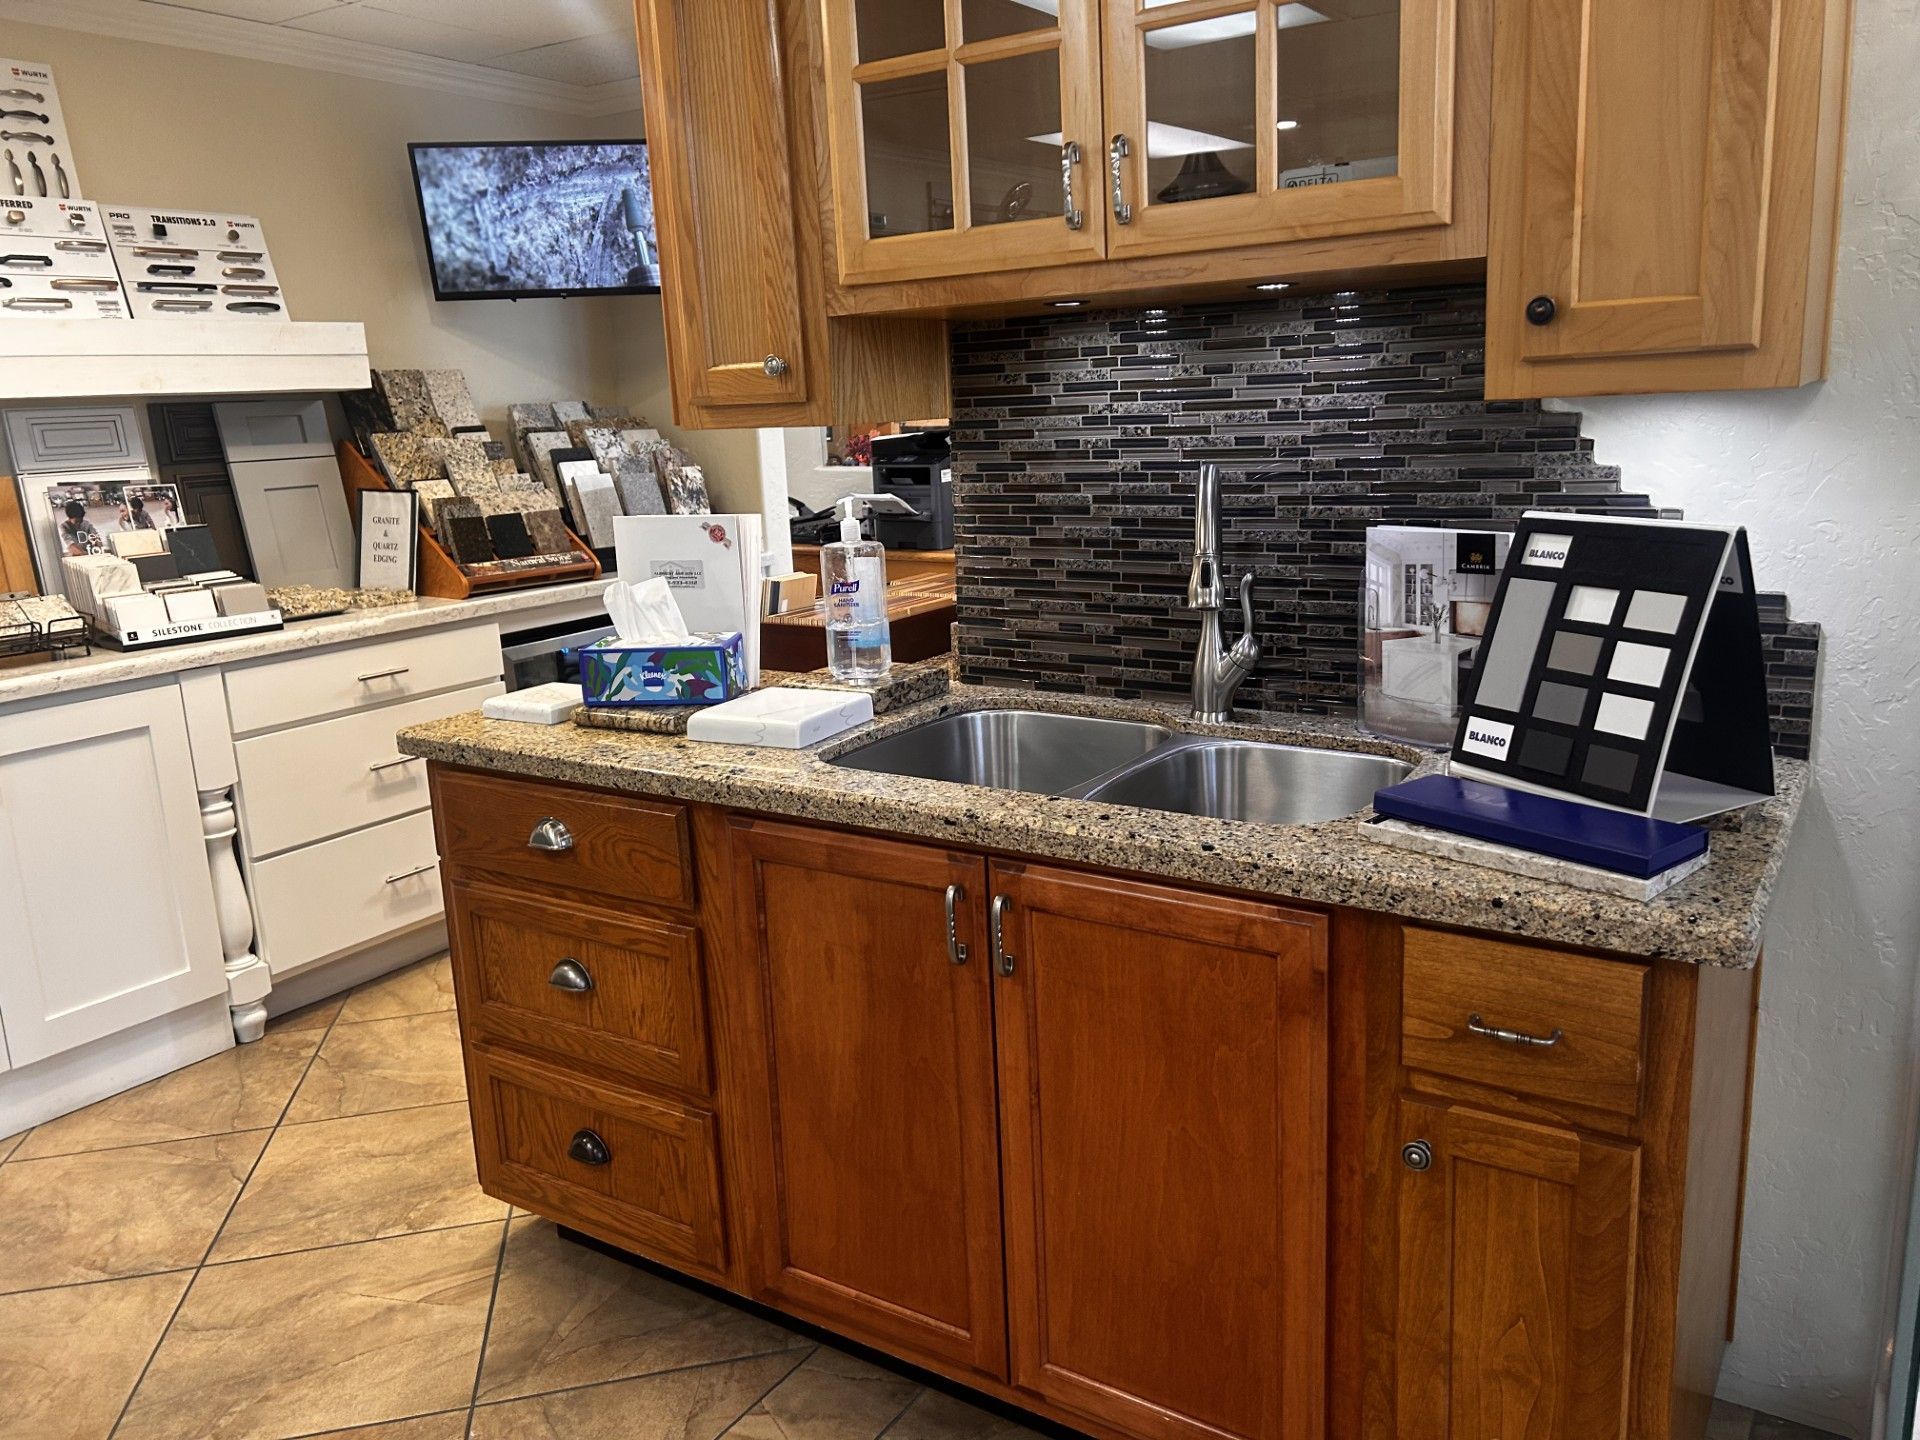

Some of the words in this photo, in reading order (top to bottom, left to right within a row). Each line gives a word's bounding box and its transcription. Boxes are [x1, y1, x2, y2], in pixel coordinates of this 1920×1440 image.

[150, 214, 201, 226] TRANSITIONS
[202, 218, 216, 227] 2.0
[372, 516, 400, 525] GRANITE
[372, 541, 398, 551] QUARTZ
[373, 554, 398, 563] EDGING
[1528, 548, 1565, 560] BLANCO
[833, 582, 857, 593] Purell
[151, 623, 203, 637] SILESTONE
[208, 616, 257, 630] COLLECTION
[640, 670, 667, 681] Kleenex
[1469, 730, 1506, 747] BLANCO
